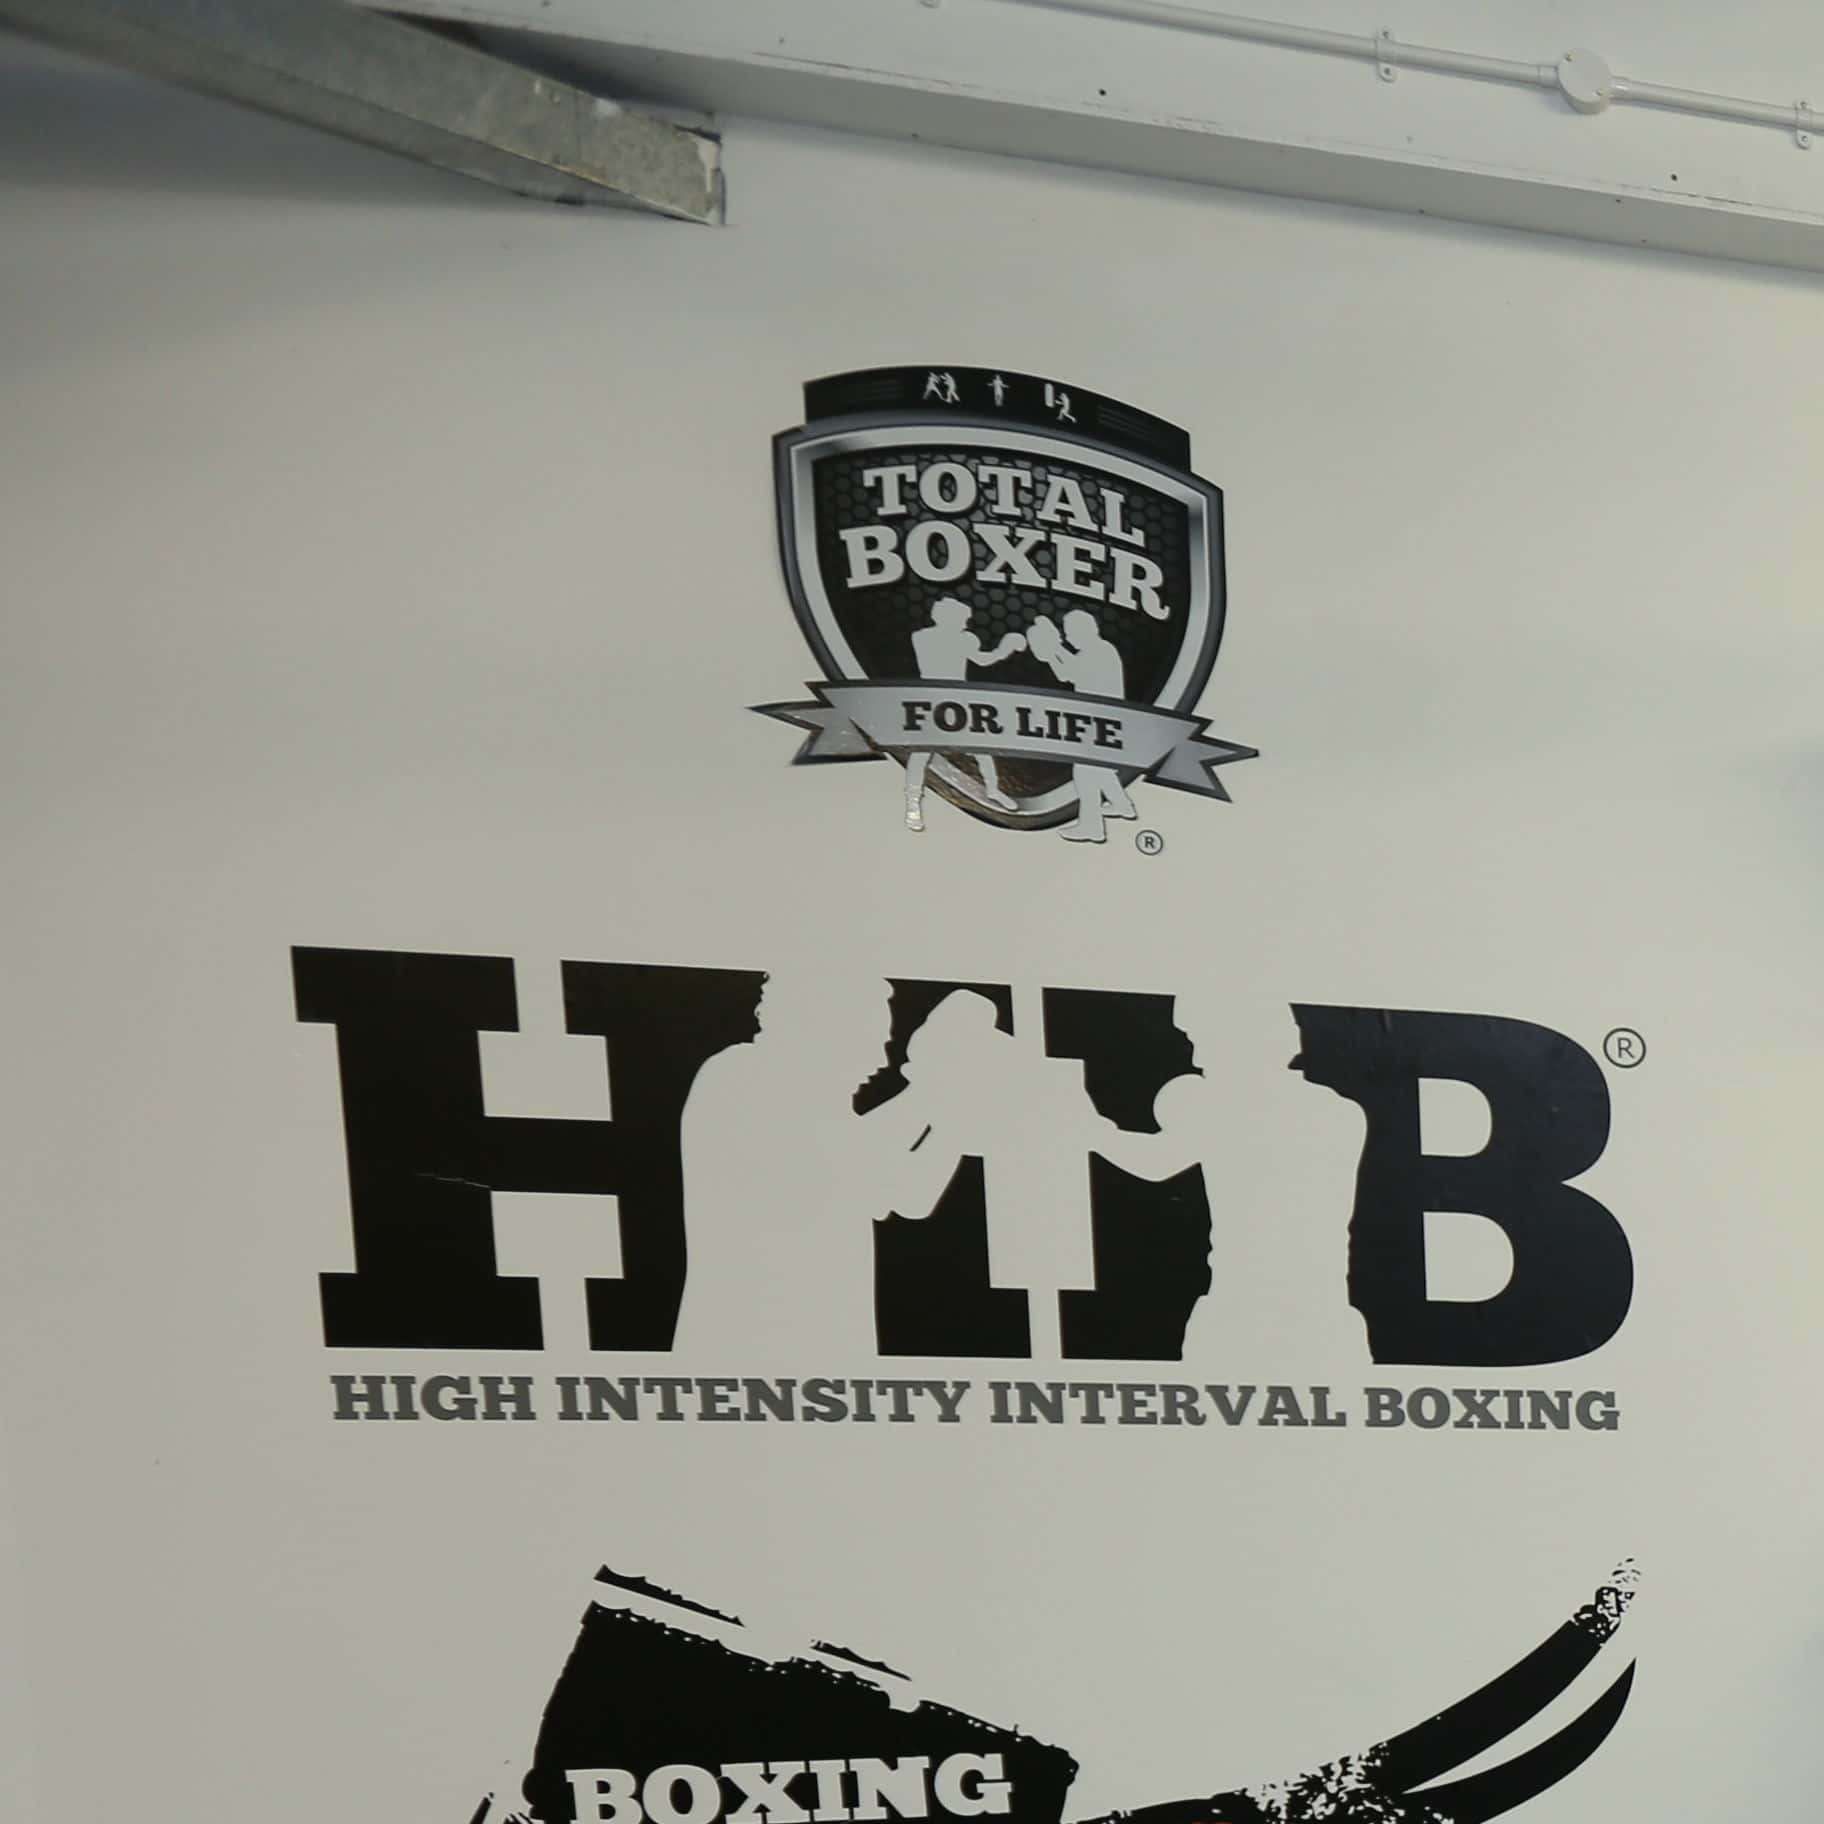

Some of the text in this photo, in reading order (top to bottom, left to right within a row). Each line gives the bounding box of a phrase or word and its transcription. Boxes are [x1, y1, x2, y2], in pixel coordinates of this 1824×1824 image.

[863, 463, 1145, 546] TOTAL
[840, 520, 1170, 620] BOXER
[902, 701, 1123, 750] FOR LIFE
[331, 1375, 1620, 1431] HIGH INTENSITY INTERVAL BOXING
